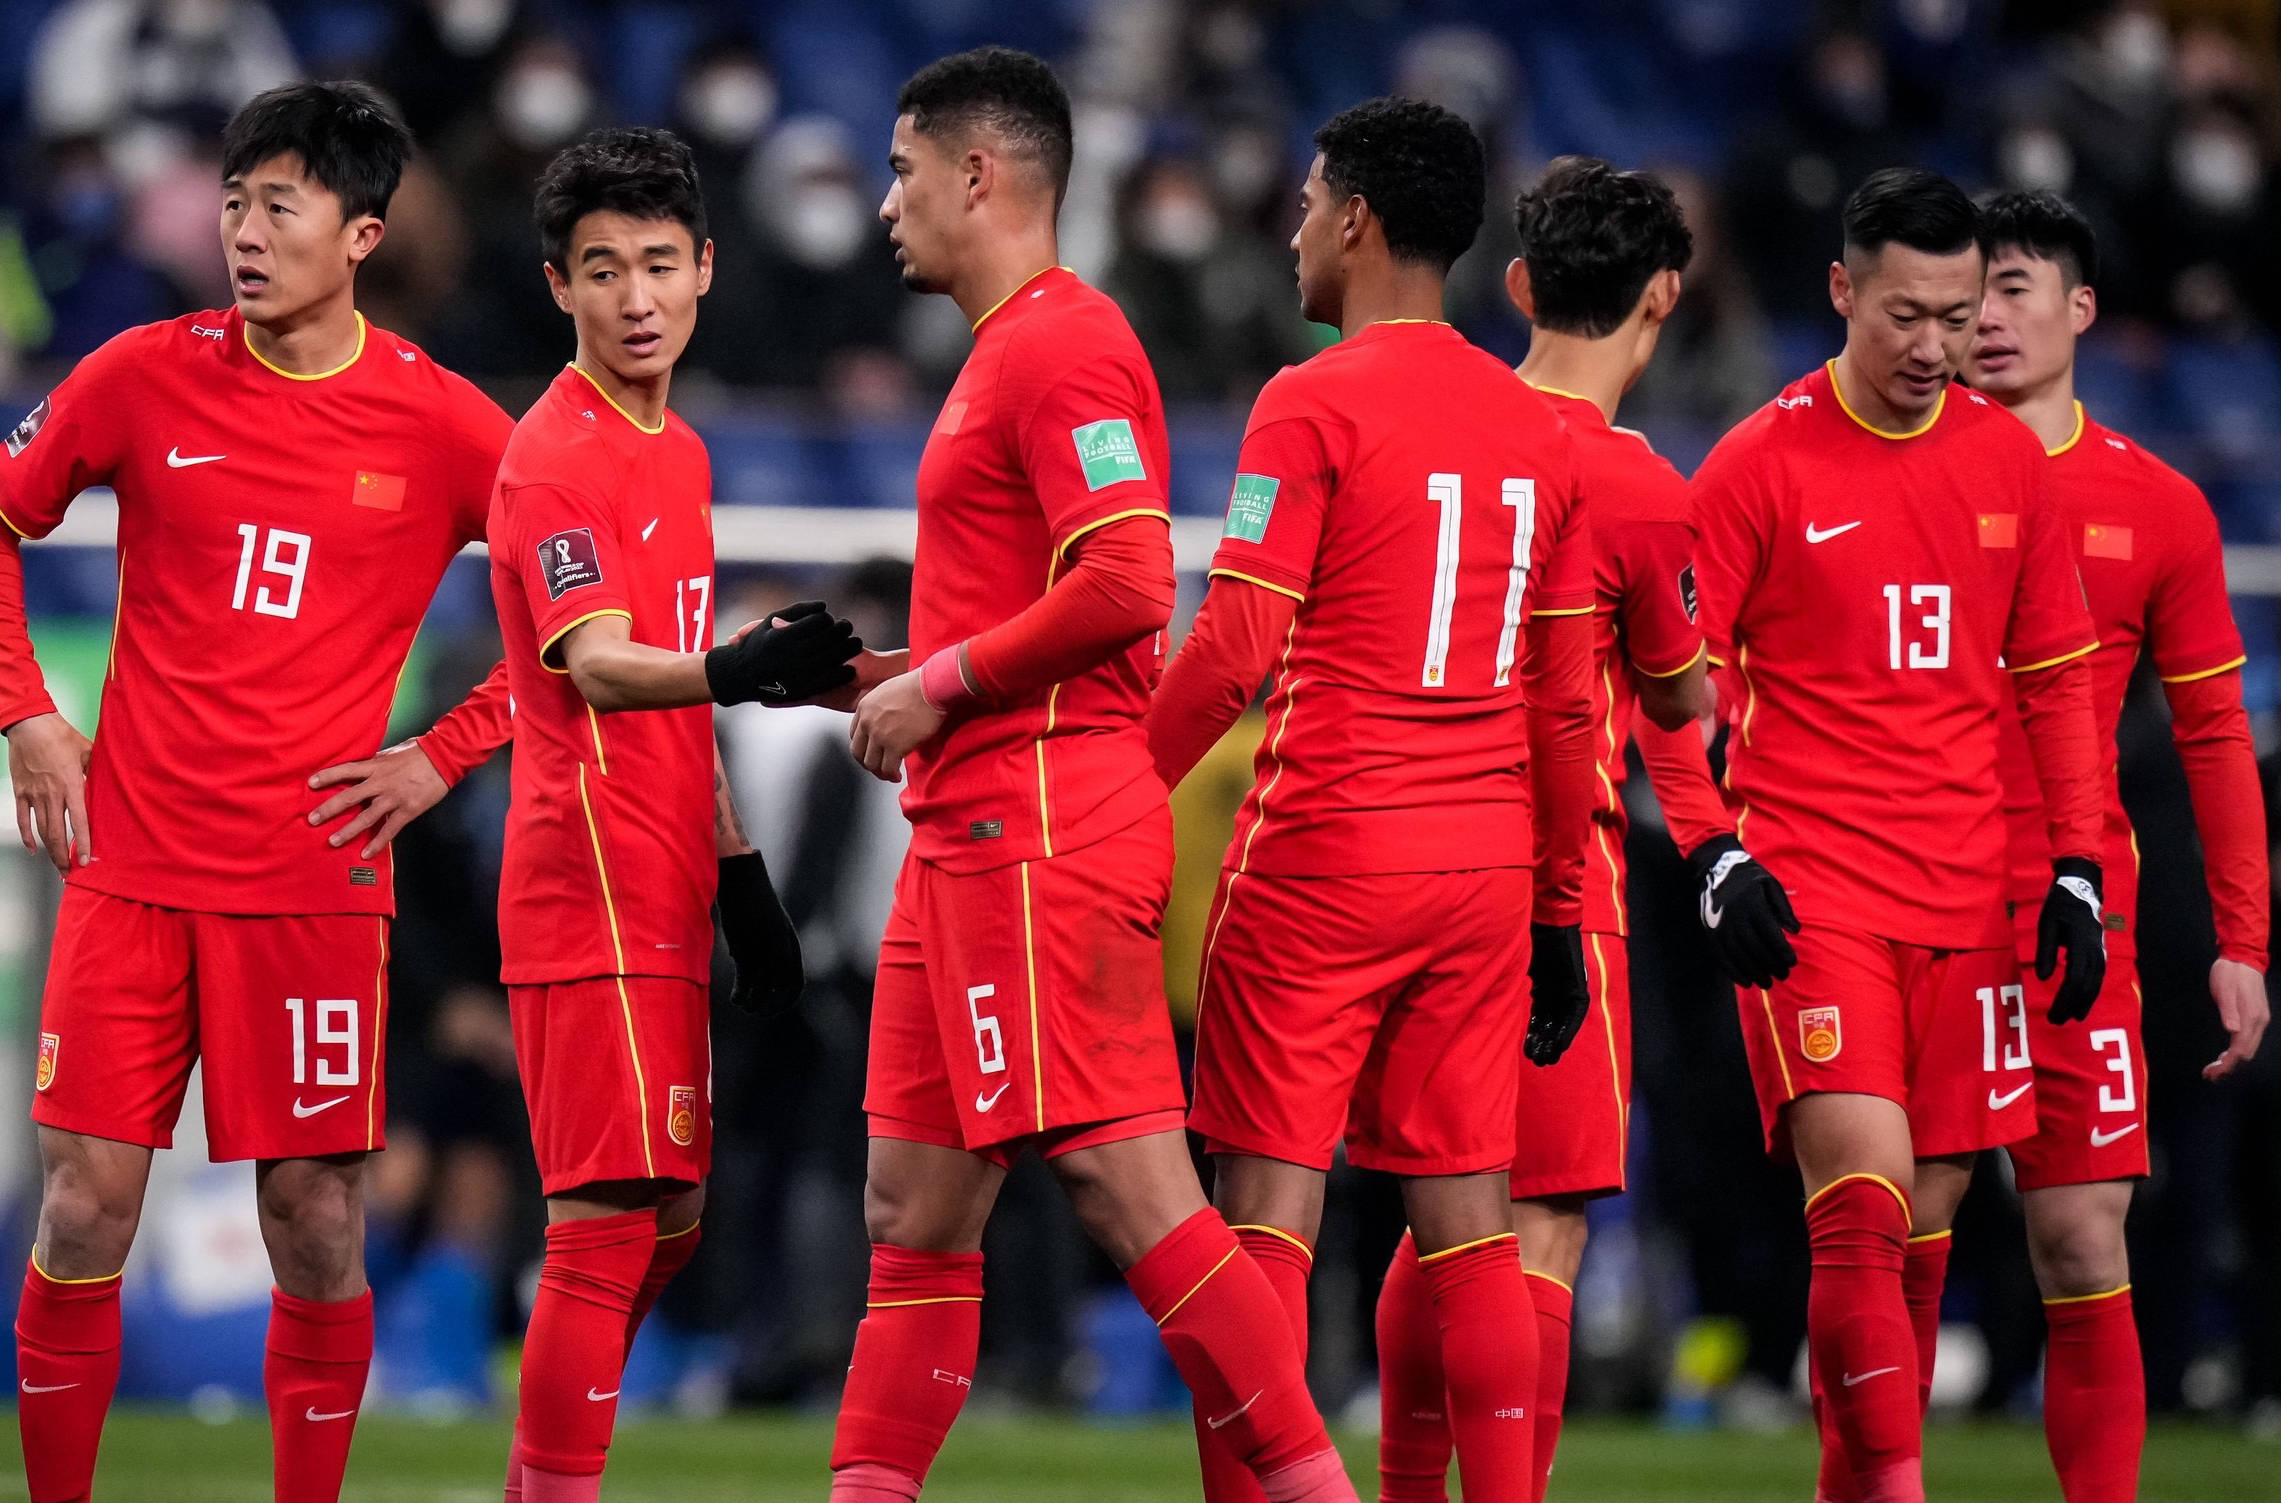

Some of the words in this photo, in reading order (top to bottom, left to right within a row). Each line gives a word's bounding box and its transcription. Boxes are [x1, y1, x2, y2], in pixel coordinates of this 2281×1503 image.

[190, 324, 225, 341] CFA
[1234, 492, 1270, 503] LIVING
[231, 523, 312, 619] 19
[676, 575, 711, 654] 17
[1422, 472, 1536, 688] 11
[1883, 584, 1951, 670] 13
[285, 998, 359, 1086] 19
[967, 983, 1006, 1075] 6
[1975, 984, 2033, 1072] 13
[2089, 1028, 2136, 1113] 3
